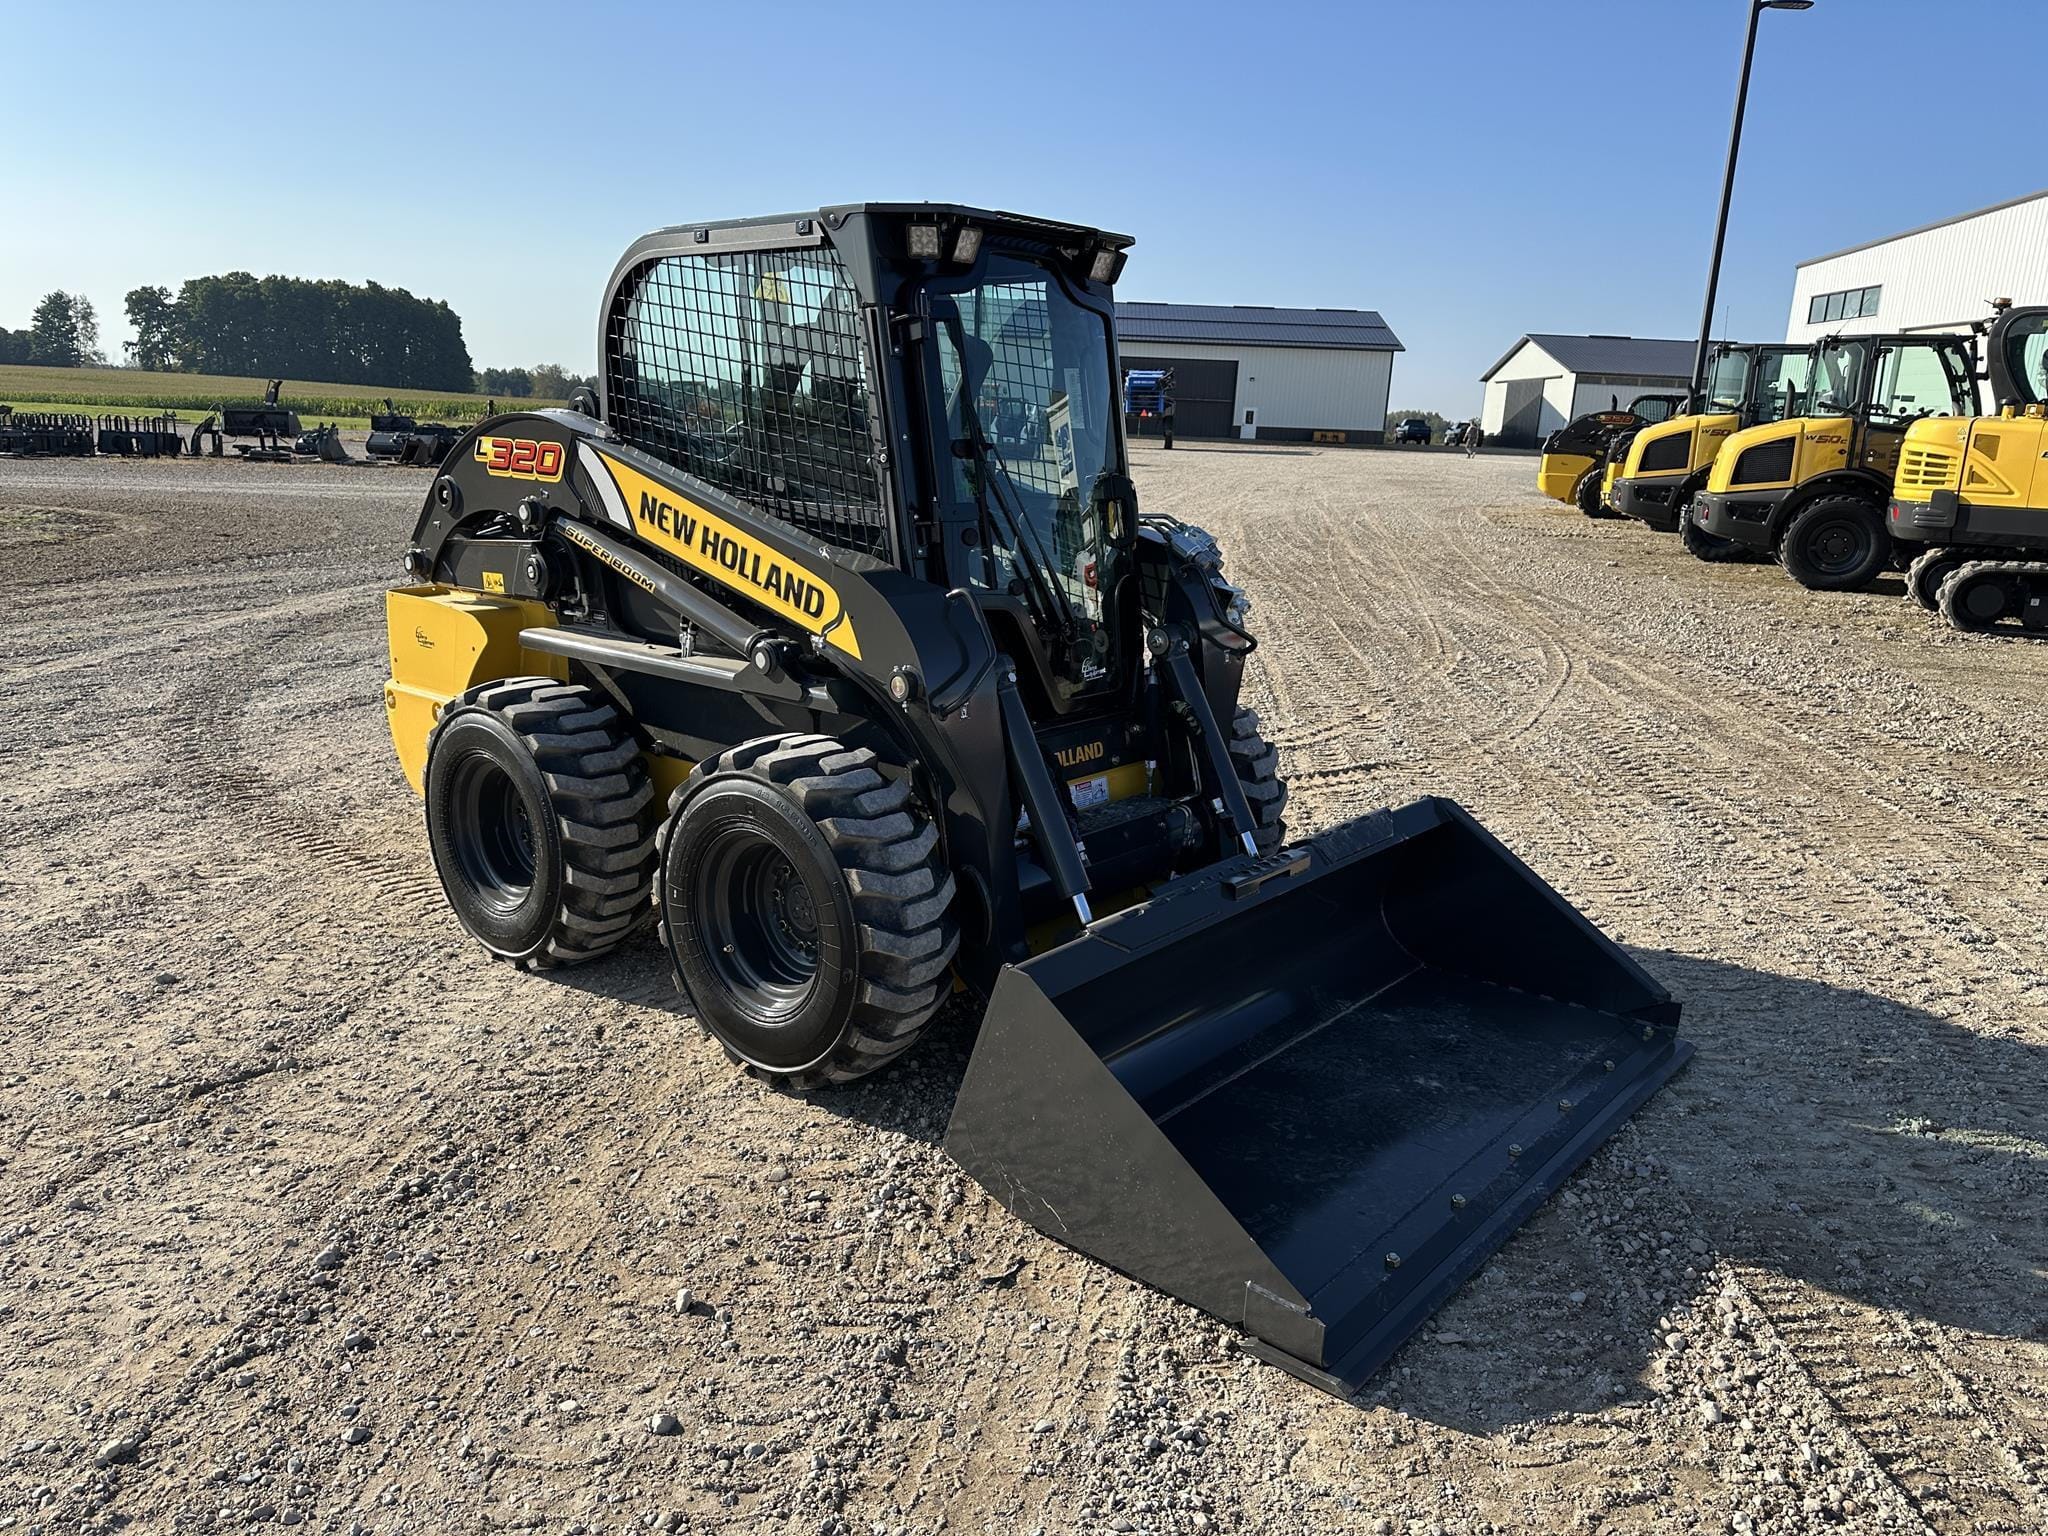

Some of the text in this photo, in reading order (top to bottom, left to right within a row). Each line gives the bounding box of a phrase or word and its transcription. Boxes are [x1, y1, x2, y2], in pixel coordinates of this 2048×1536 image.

[475, 437, 564, 480] L320
[639, 491, 825, 619] NEW HOLLAND
[1054, 741, 1104, 767] LLAND
